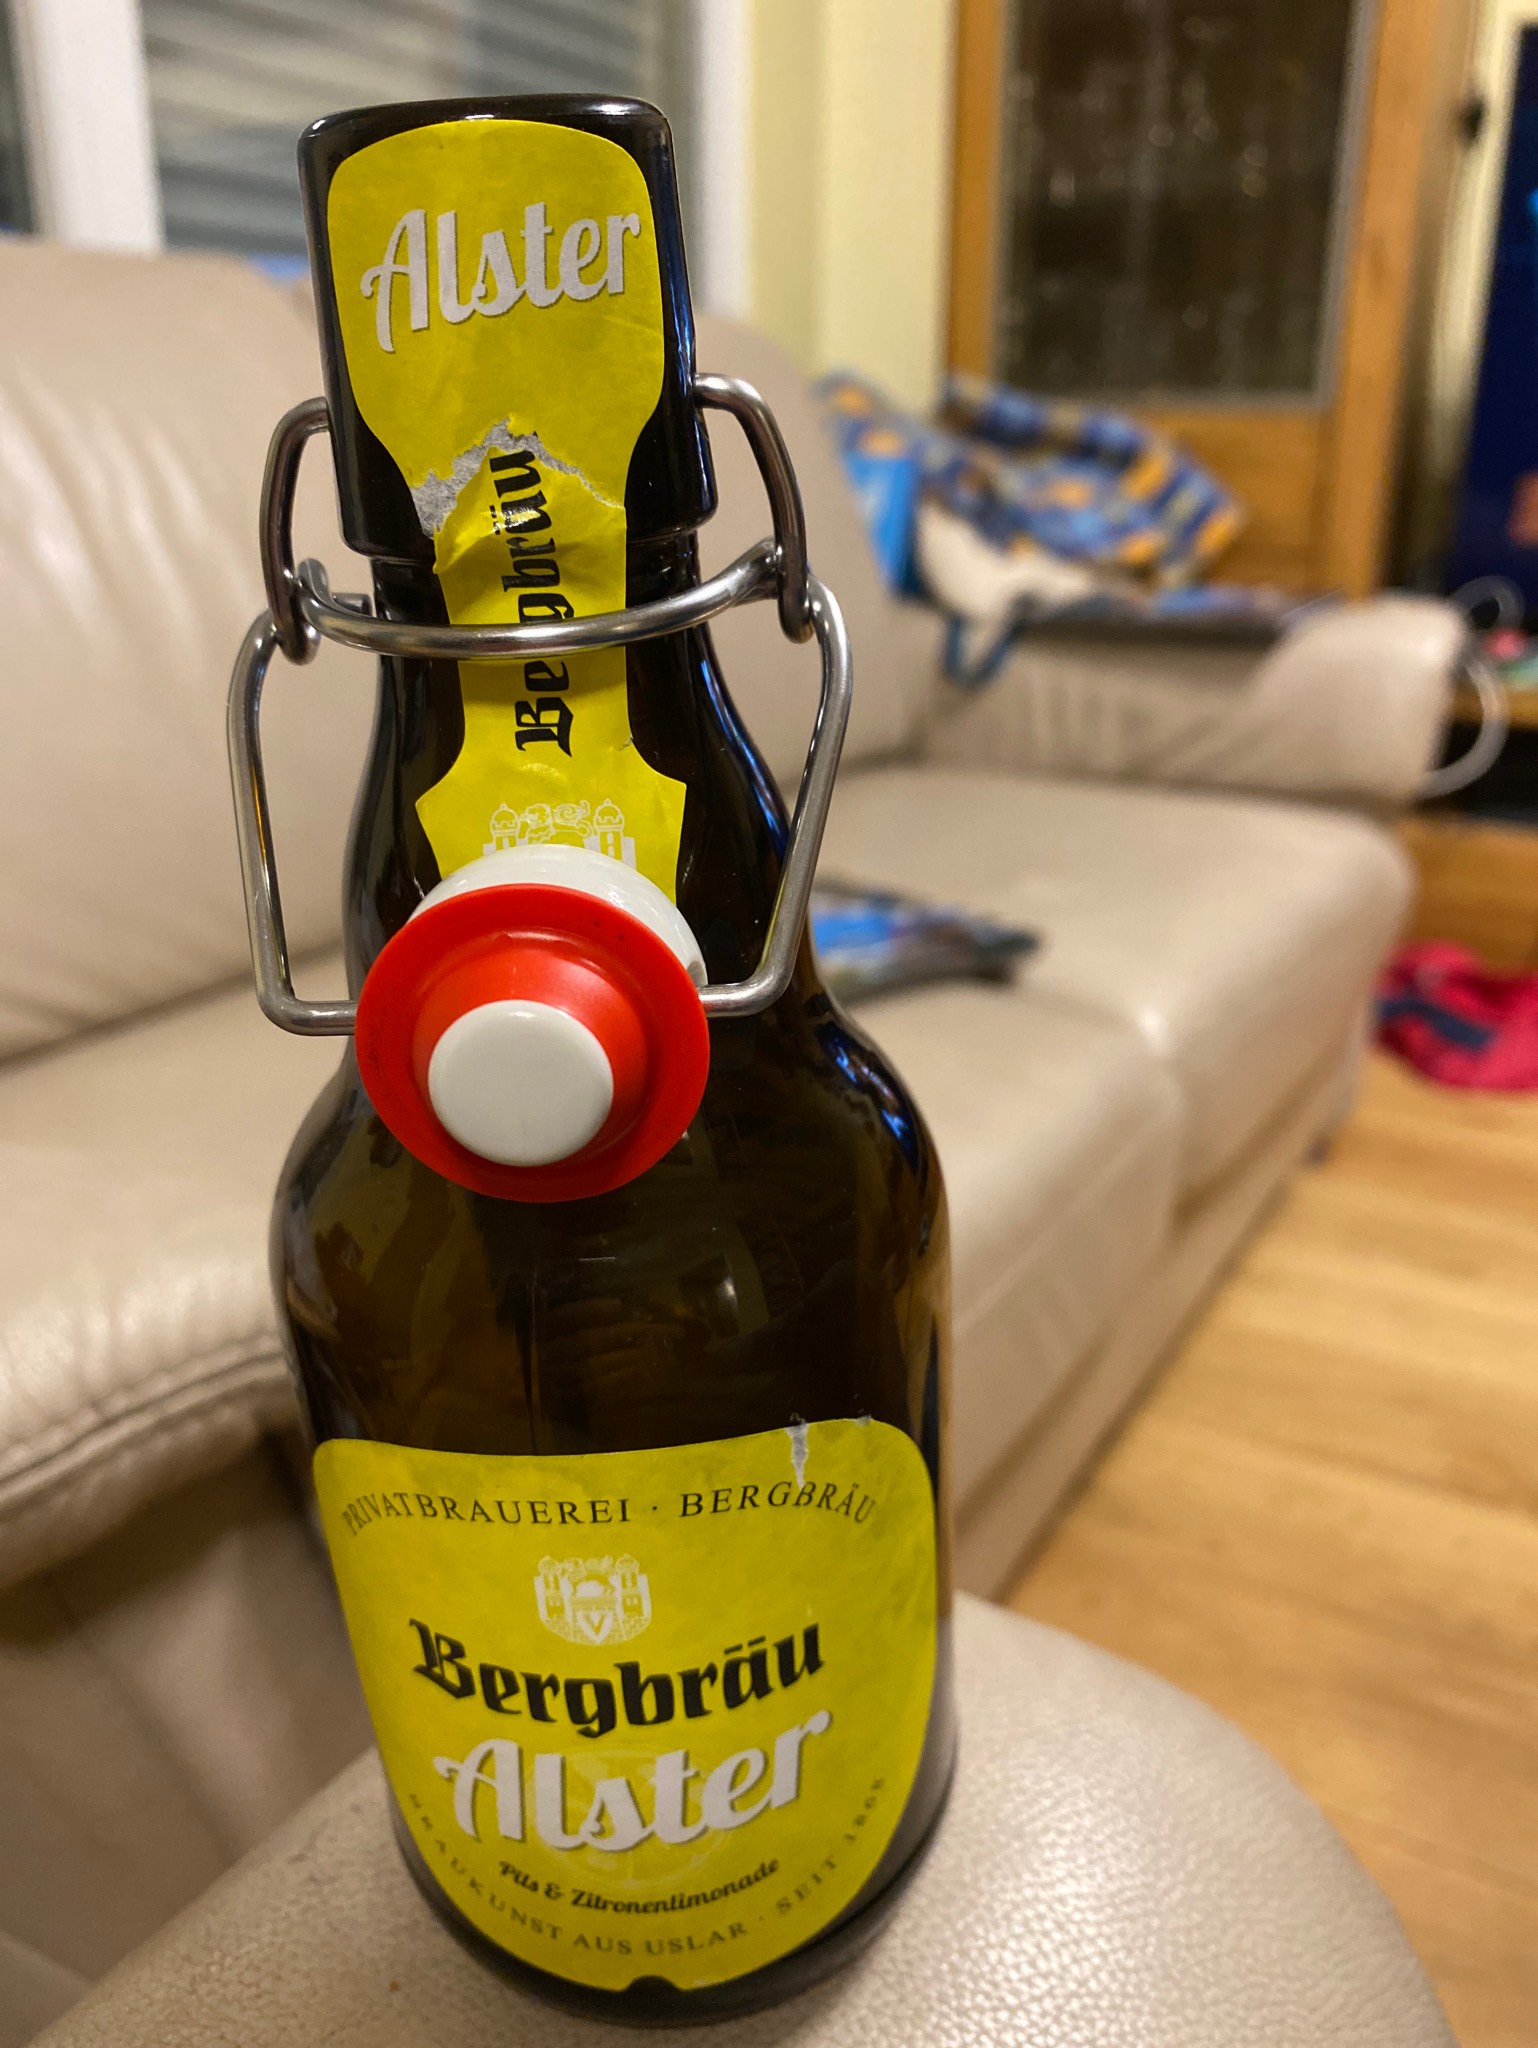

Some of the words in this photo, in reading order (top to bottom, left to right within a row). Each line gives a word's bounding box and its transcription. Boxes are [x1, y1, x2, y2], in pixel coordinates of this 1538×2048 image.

[360, 201, 642, 355] Alster
[489, 448, 574, 758] Begbräu
[341, 1491, 631, 1538] PRIVATBRAUEREI
[679, 1481, 876, 1524] BERGBRÄU
[409, 1617, 825, 1739] Bergbräu
[432, 1709, 833, 1853] Alster
[498, 1860, 540, 1894] Pils
[543, 1881, 564, 1901] &
[569, 1858, 781, 1915] Zitronenlimonade
[572, 1921, 634, 1956] AUS
[644, 1919, 748, 1957] USLAR
